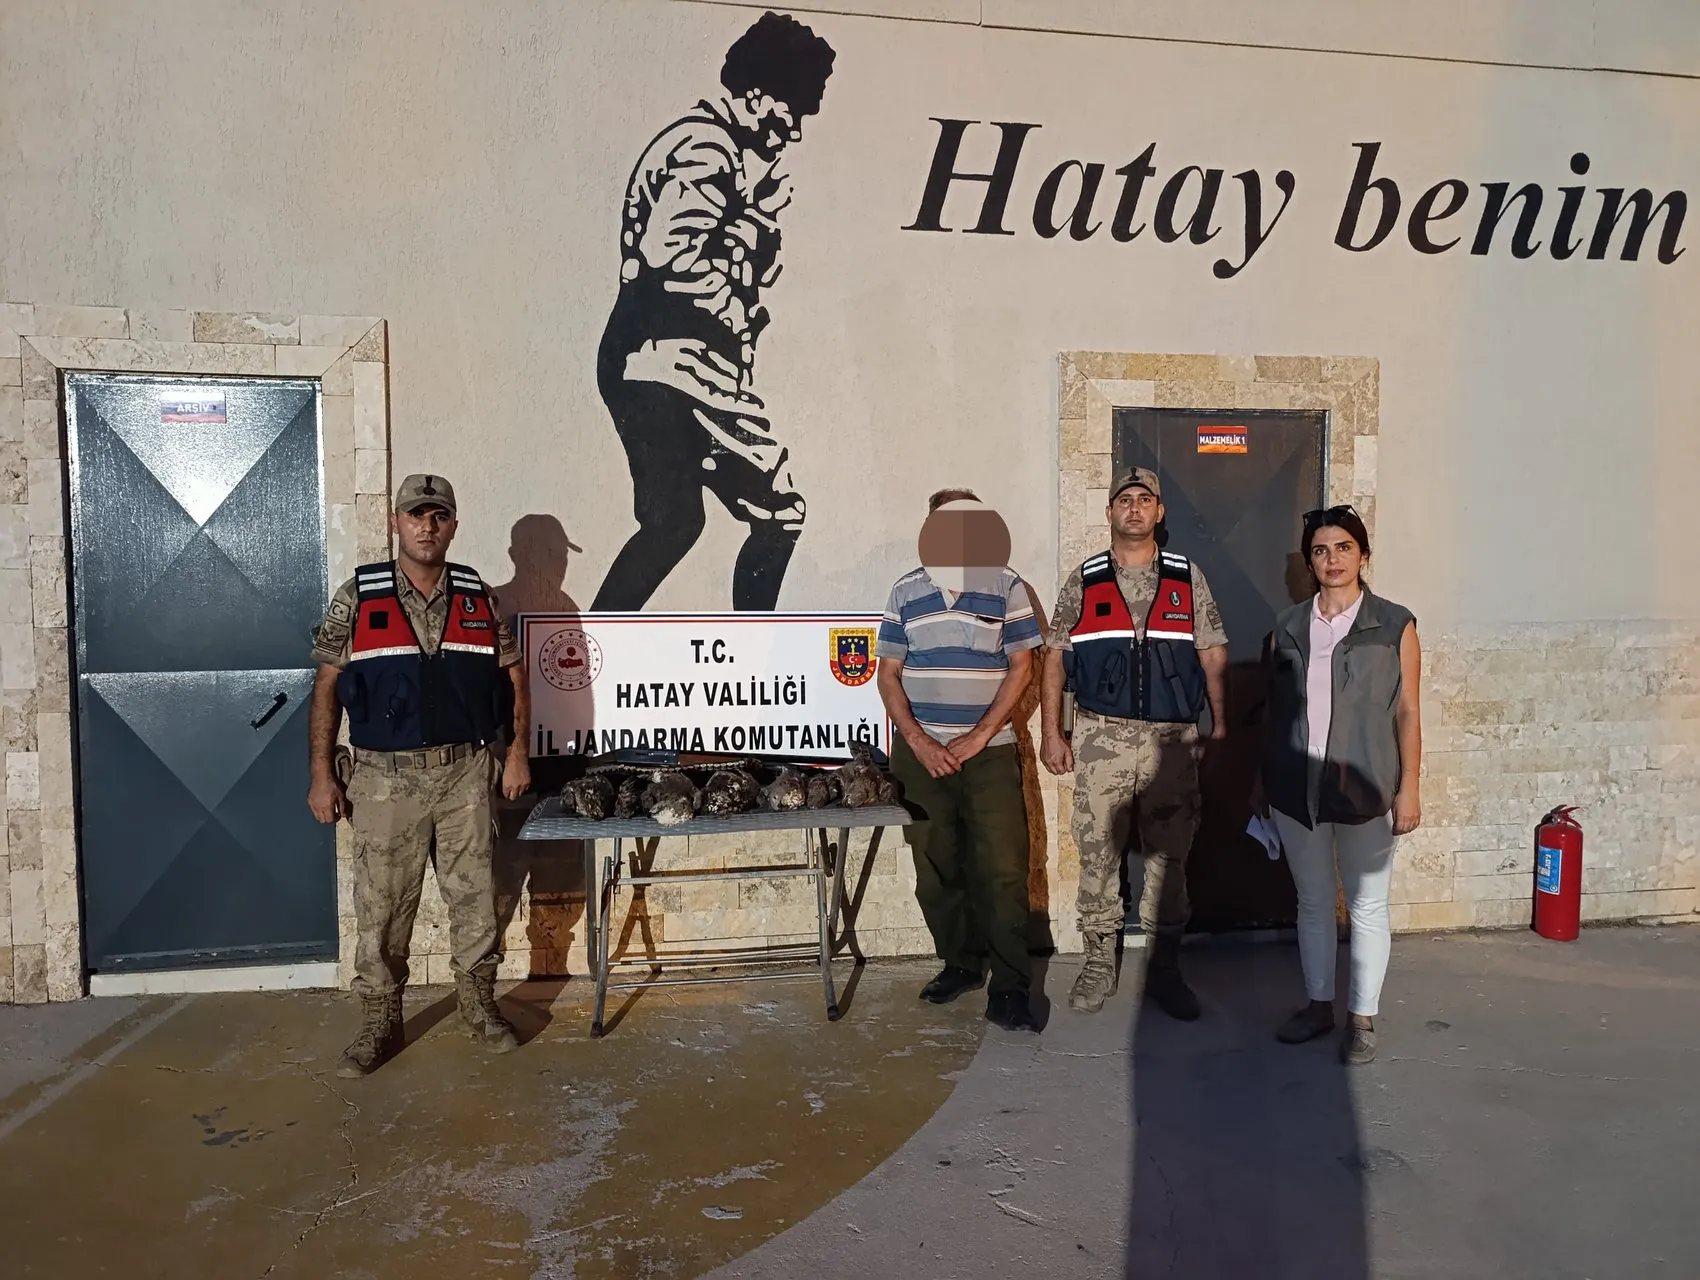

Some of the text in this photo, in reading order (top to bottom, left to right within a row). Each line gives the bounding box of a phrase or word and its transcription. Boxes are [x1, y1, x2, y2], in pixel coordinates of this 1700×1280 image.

[901, 117, 1688, 279] Hatay benim
[1200, 434, 1246, 445] MALZEMELİK 1
[690, 639, 734, 663] T.C.
[832, 666, 875, 685] JANDARMA
[616, 675, 806, 708] HATAY VALİLİĞİ
[537, 717, 879, 756] İL JANDARMA KOMUTANLIĞI
